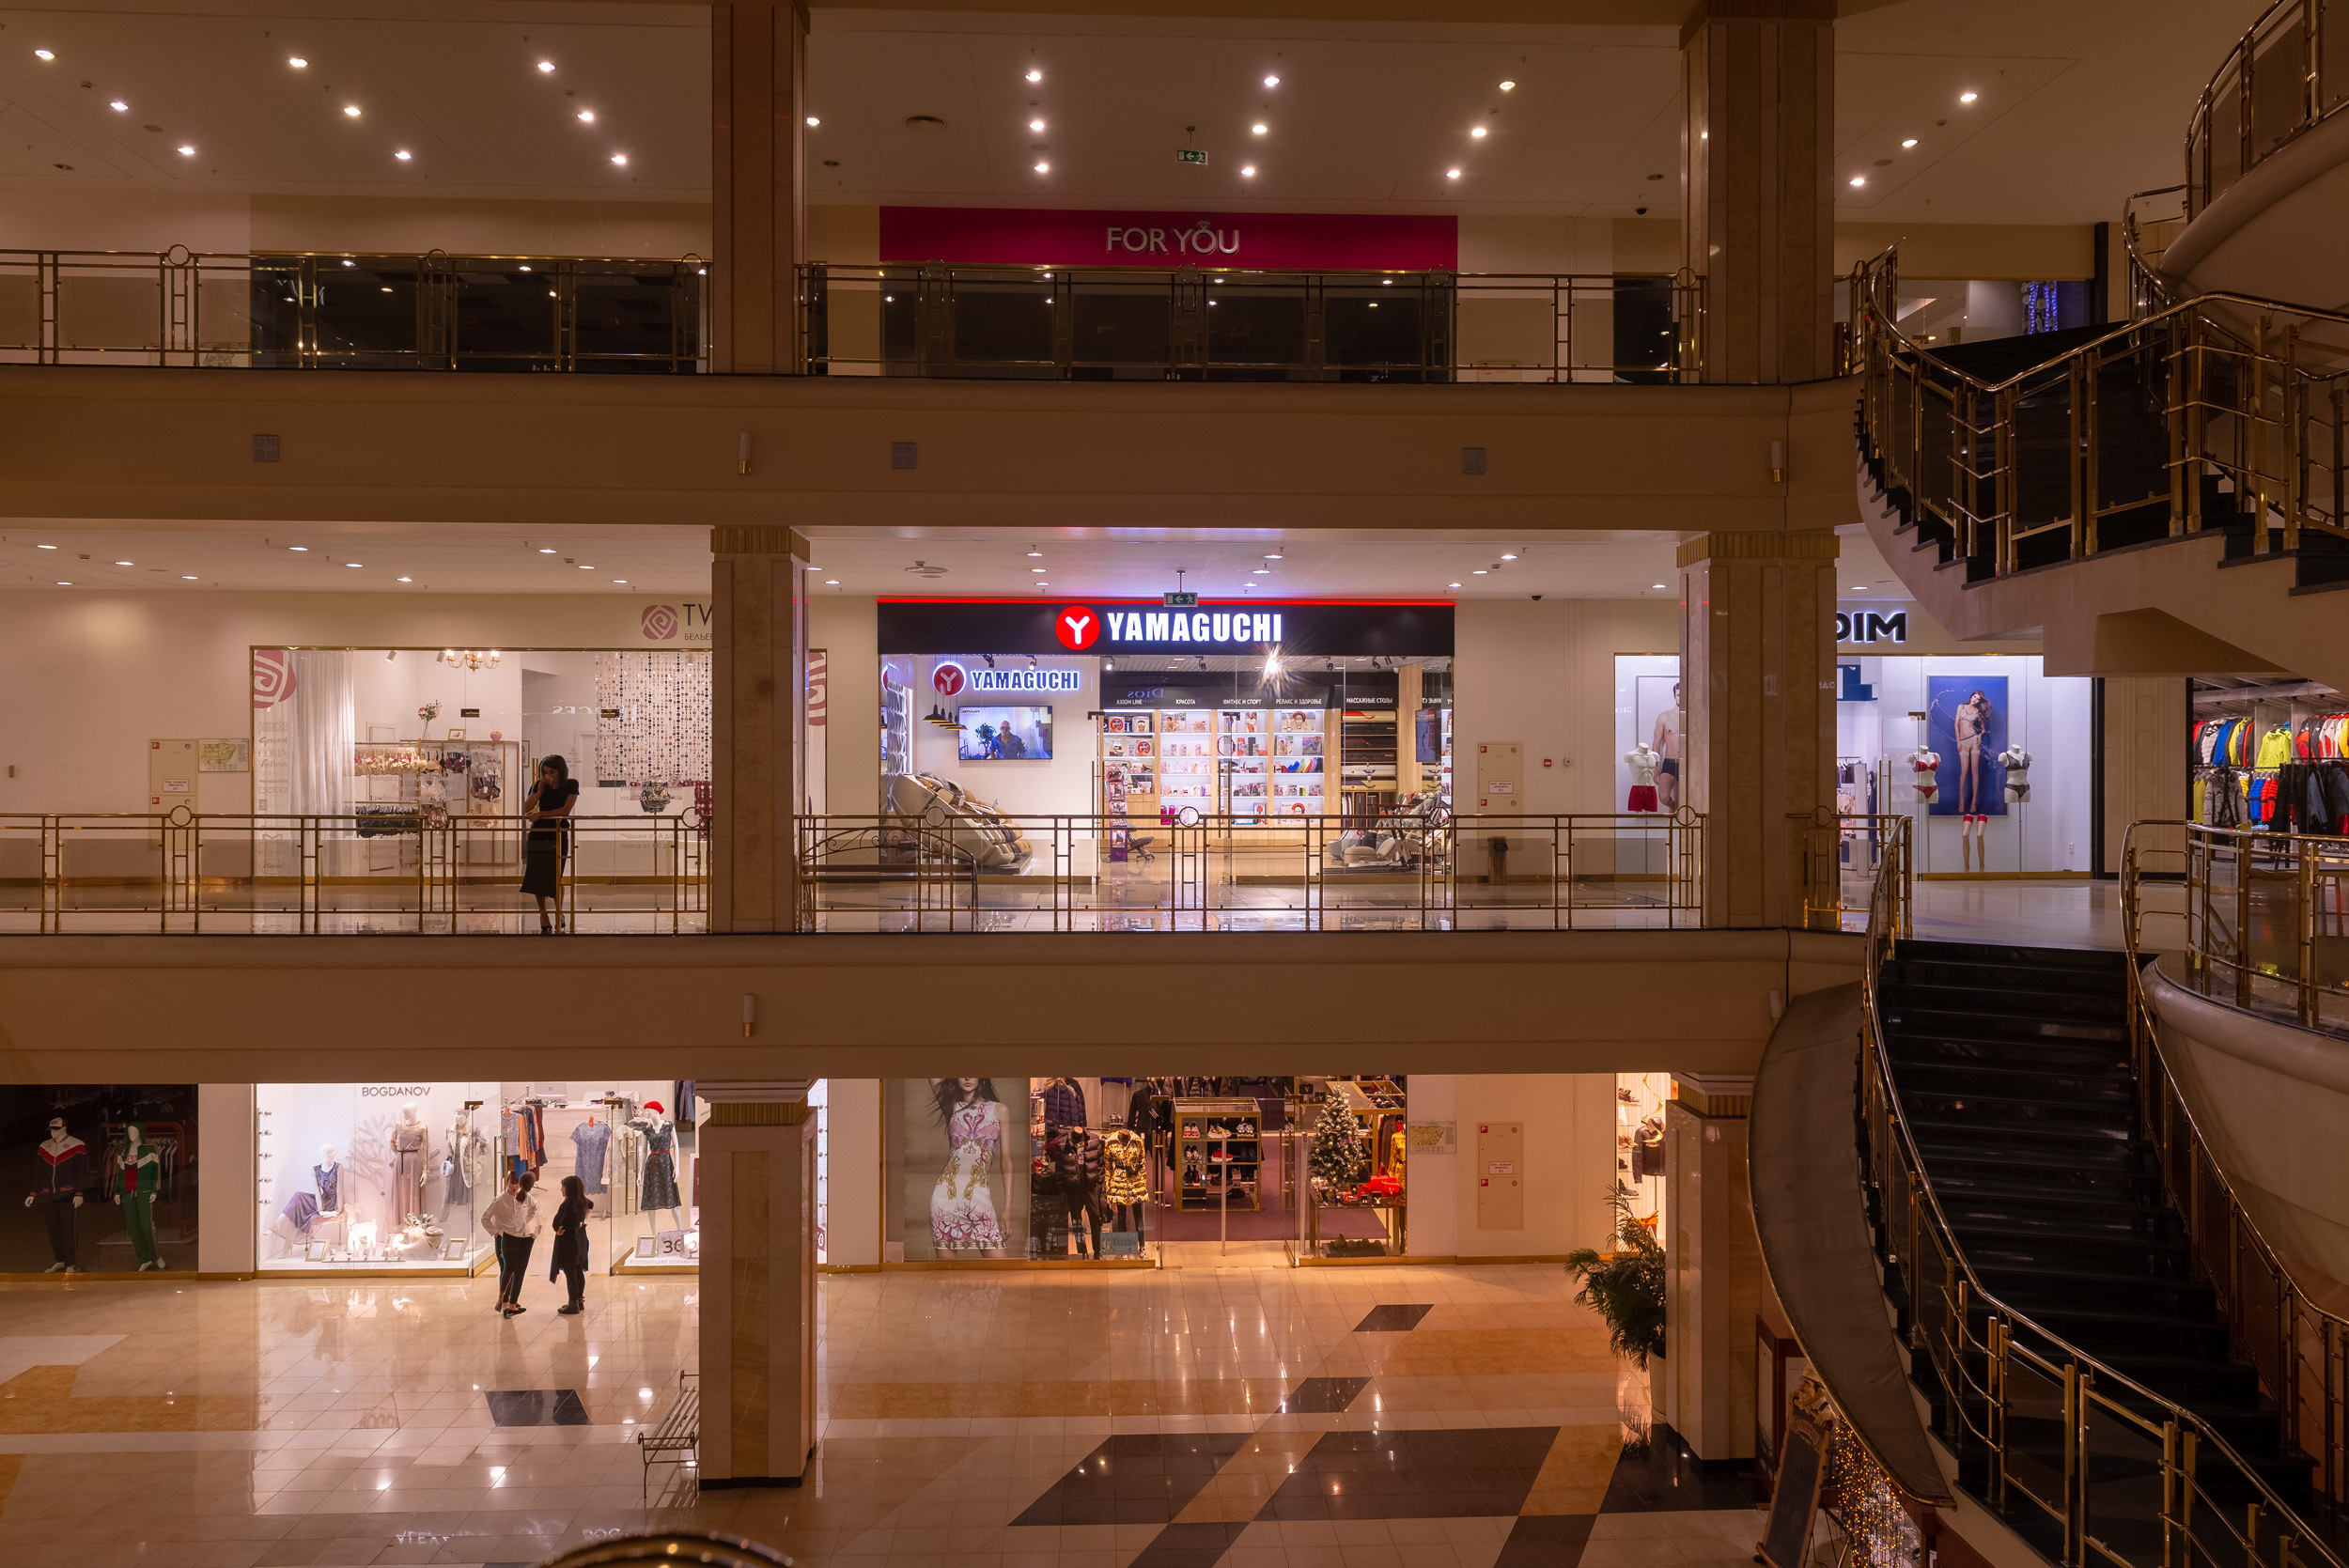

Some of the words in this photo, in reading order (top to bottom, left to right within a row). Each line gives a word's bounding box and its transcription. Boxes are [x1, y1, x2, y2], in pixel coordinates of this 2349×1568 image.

[1106, 226, 1167, 254] FOR
[1171, 225, 1240, 255] YOU
[1107, 612, 1282, 643] YAMAGUCHI
[971, 671, 1080, 691] YAMAGUCHI
[362, 1086, 431, 1096] BOGDANOV
